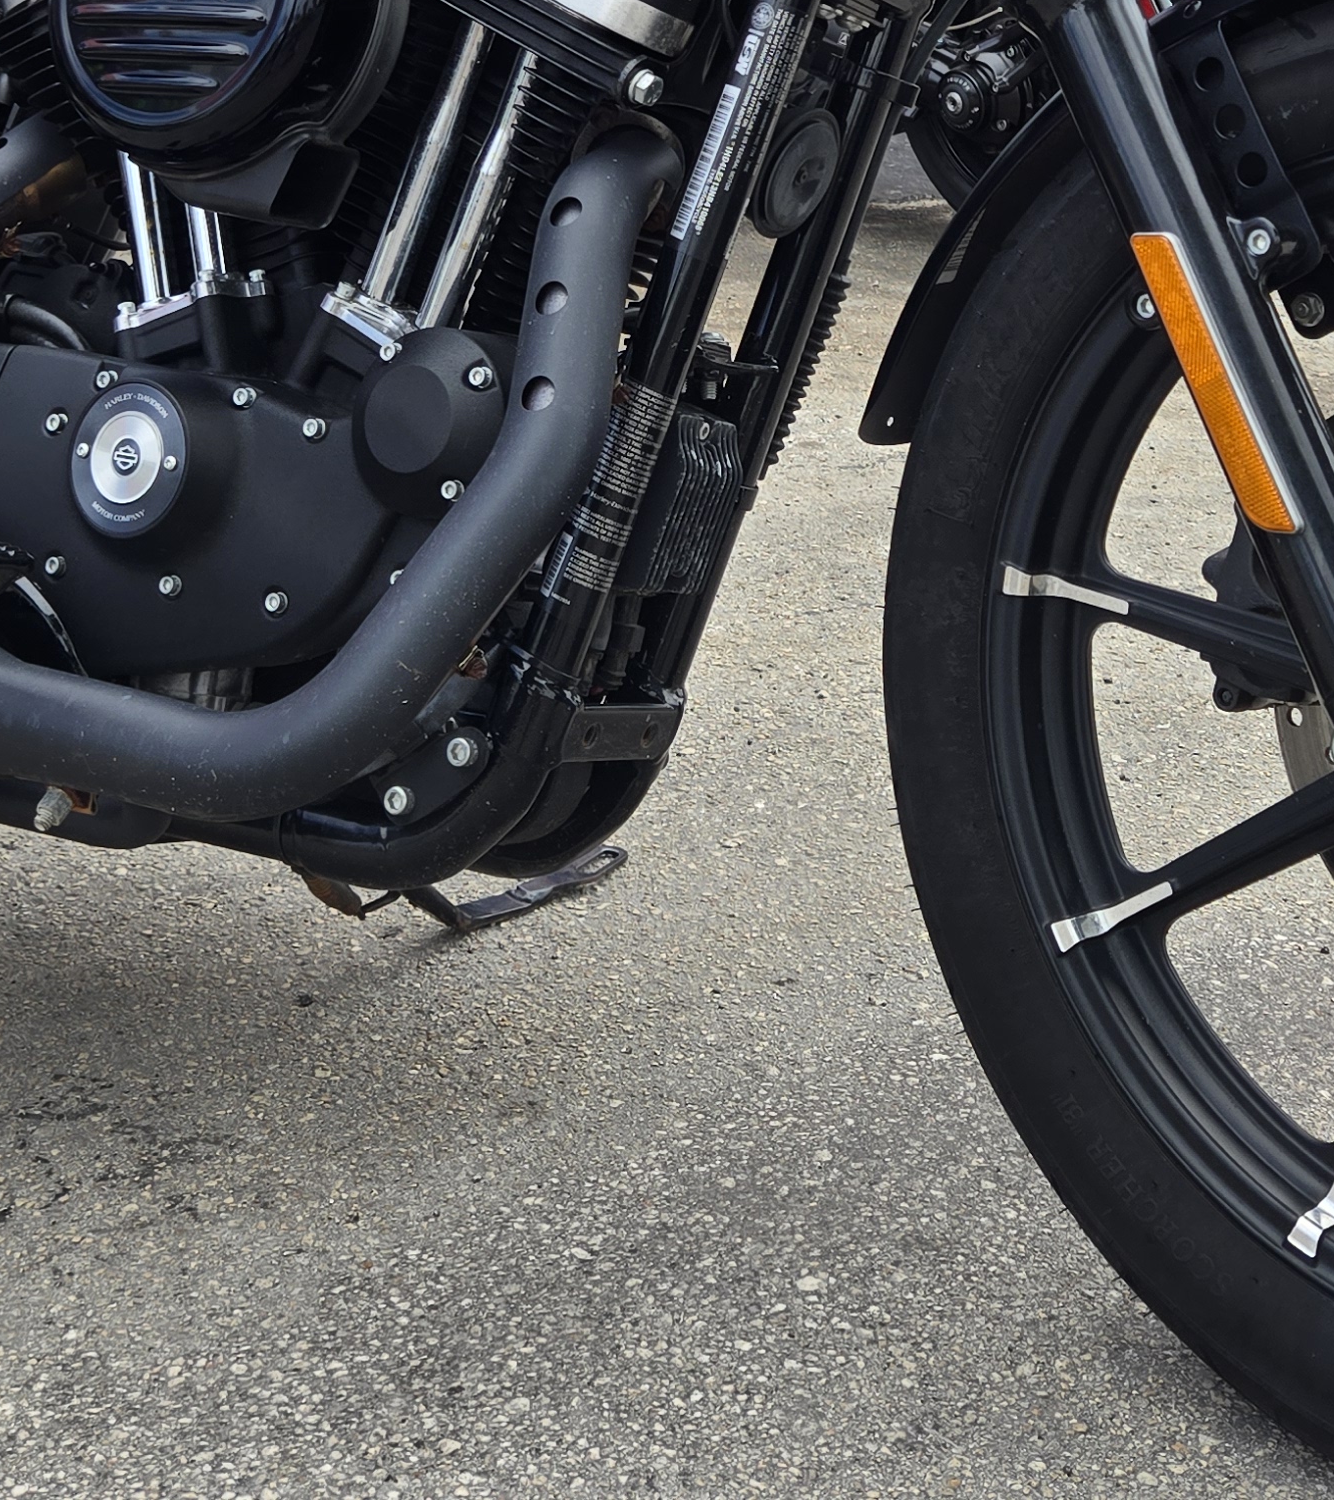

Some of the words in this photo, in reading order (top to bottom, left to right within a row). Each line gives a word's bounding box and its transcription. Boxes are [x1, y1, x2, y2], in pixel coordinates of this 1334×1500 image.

[91, 500, 114, 521] MOTOR
[113, 509, 146, 523] COMPANY
[1086, 1132, 1236, 1296] SCORCHER
